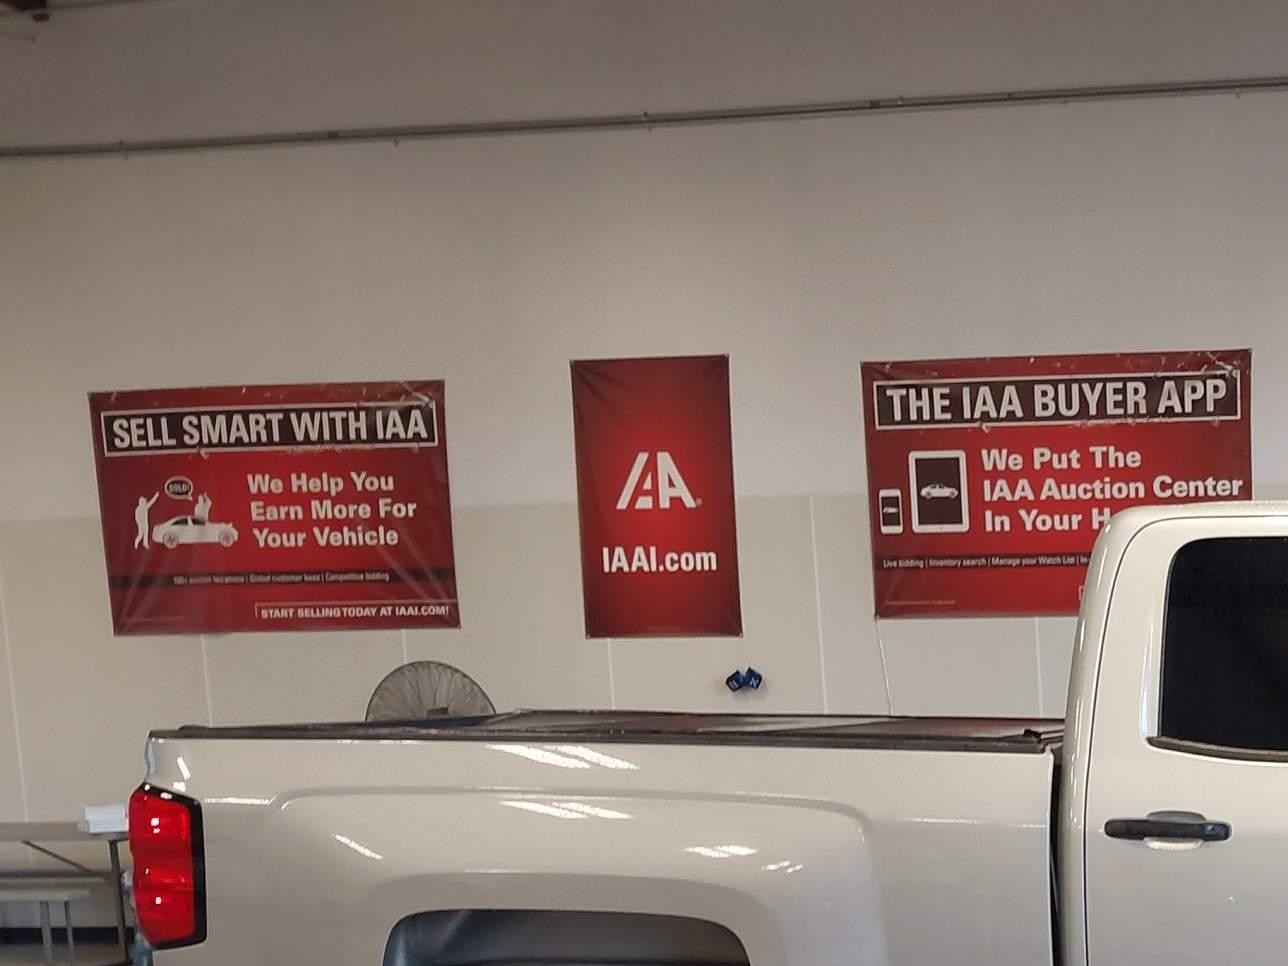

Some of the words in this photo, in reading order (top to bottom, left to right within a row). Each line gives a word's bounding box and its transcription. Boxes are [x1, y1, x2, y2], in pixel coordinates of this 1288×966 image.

[886, 387, 951, 421] THE
[962, 384, 1024, 419] IAA
[1033, 381, 1148, 418] BUYER
[1157, 378, 1227, 414] APP
[112, 416, 177, 449] SELL
[183, 412, 284, 446] SMART
[289, 410, 371, 443] WITH
[376, 408, 428, 440] IAA
[981, 449, 1023, 471] We
[1033, 447, 1081, 470] Put
[1089, 445, 1142, 468] The
[247, 473, 284, 494] We
[291, 472, 344, 497] Help
[350, 471, 395, 492] You
[983, 479, 1034, 501] IAA
[1040, 476, 1145, 500] Auction
[1152, 474, 1243, 498] Center
[250, 500, 304, 521] Earn
[311, 499, 371, 520] More
[378, 497, 417, 518] For
[985, 510, 1011, 532] In
[1018, 508, 1082, 532] Your
[252, 527, 306, 549] Your
[313, 525, 399, 547] Vehicle
[602, 546, 718, 573] IAAI.com
[883, 559, 897, 569] Live
[929, 558, 961, 569] Inventory
[963, 558, 986, 567] search
[992, 557, 1020, 569] Manage
[1038, 556, 1062, 566] Watch
[1063, 556, 1076, 565] List
[261, 607, 294, 619] START
[297, 606, 341, 618] SELLING
[342, 606, 377, 617] TODAY
[379, 606, 393, 616] AT
